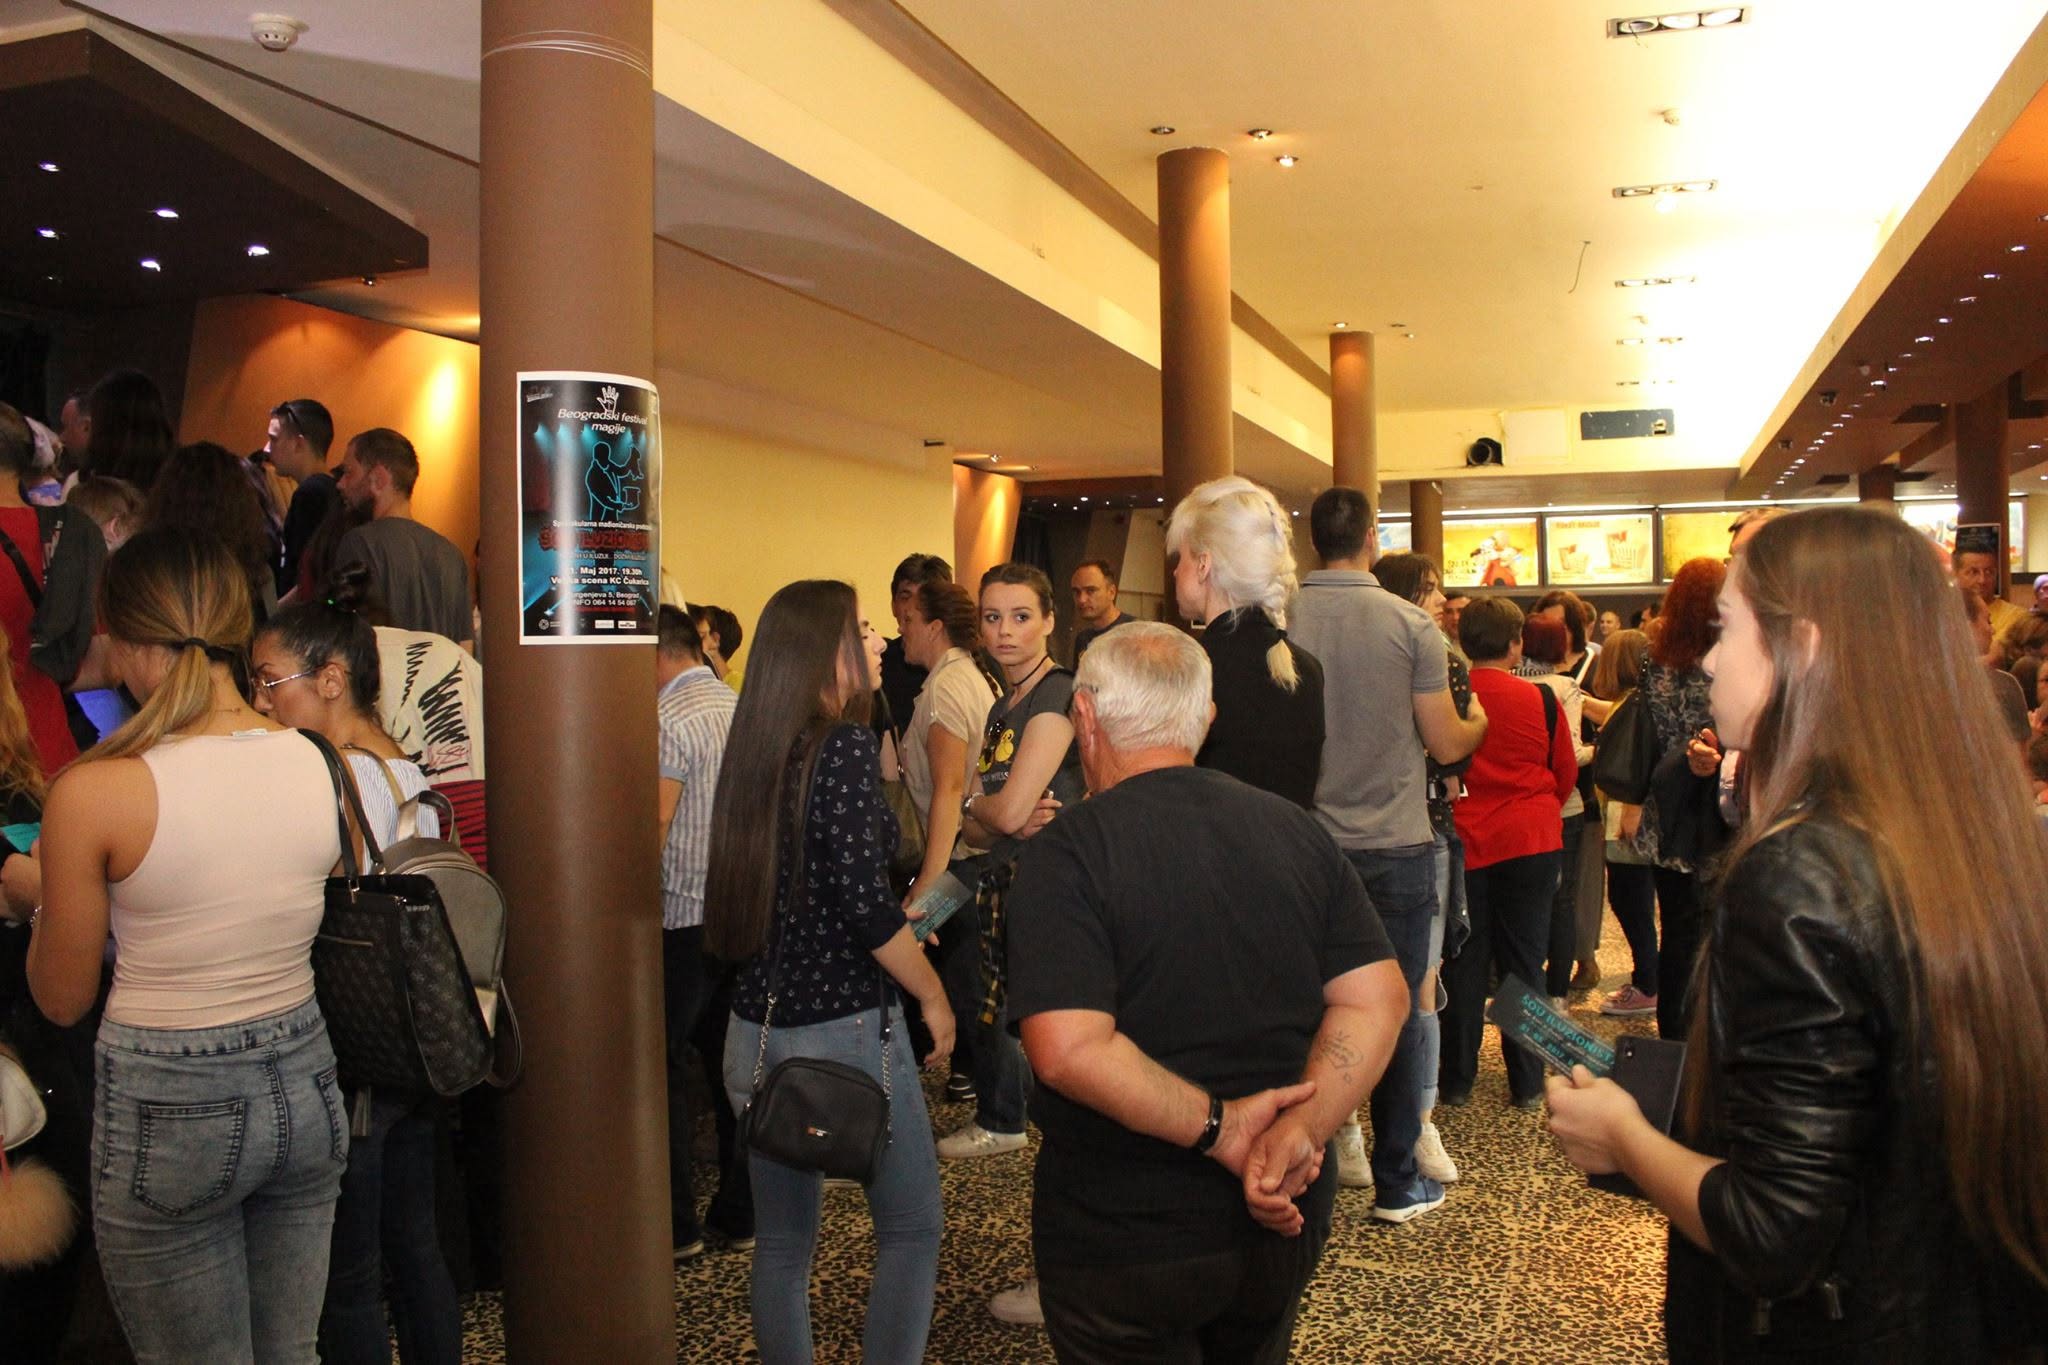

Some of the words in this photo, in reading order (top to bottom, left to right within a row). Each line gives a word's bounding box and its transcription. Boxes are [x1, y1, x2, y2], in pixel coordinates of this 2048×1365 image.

[558, 408, 620, 421] Beogradski
[621, 412, 648, 425] festival
[591, 423, 626, 434] magije
[580, 567, 597, 576] Maj
[598, 567, 620, 575] 2017.
[616, 592, 640, 600] Beograd
[1546, 1014, 1614, 1064] ILUZIONIST
